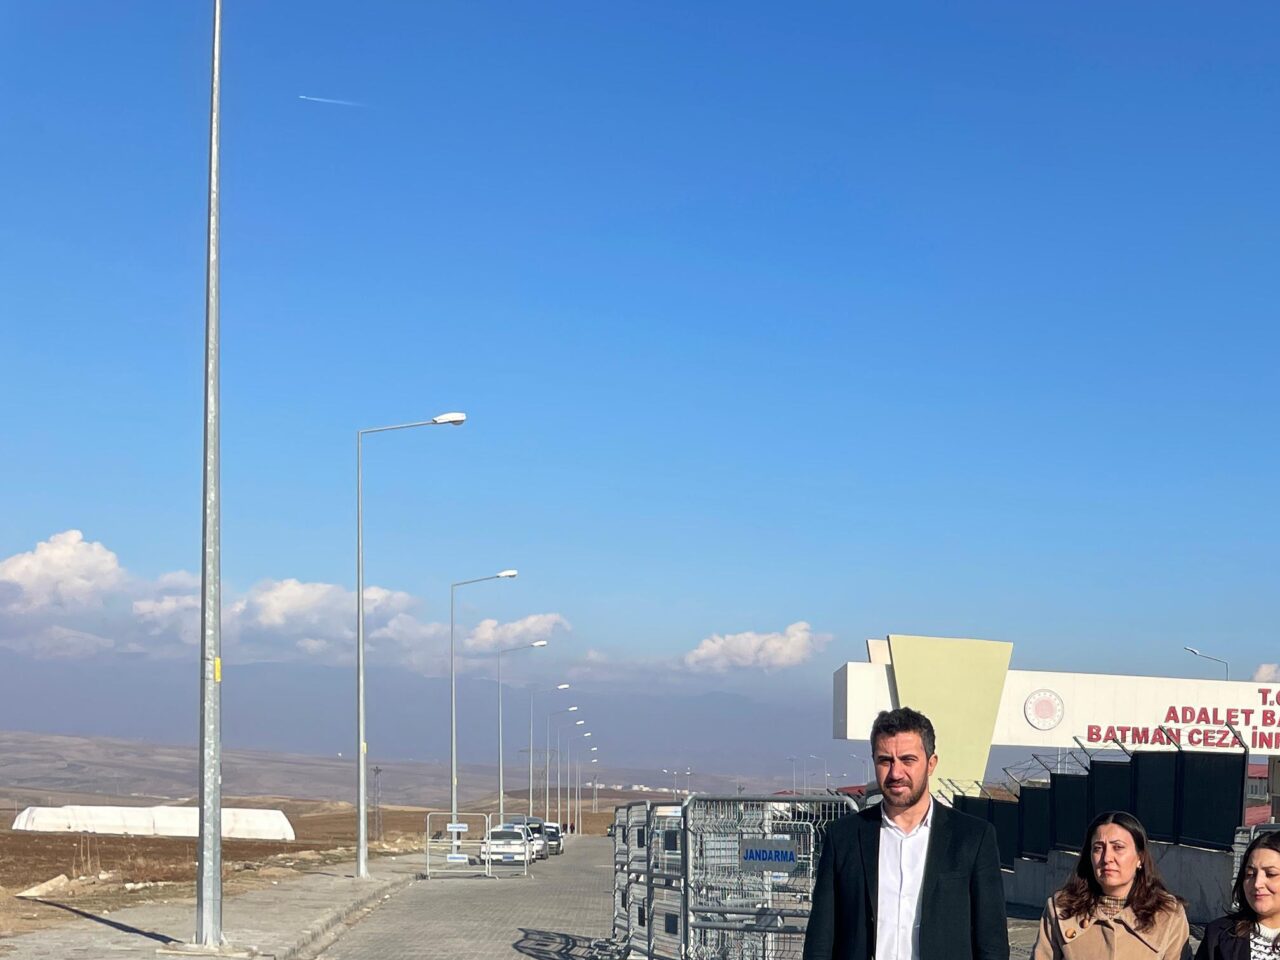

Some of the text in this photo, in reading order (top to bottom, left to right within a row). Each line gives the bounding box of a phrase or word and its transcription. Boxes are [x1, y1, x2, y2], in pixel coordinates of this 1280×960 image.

[1164, 706, 1254, 726] ADALET
[1087, 724, 1182, 746] BATMAN
[1187, 728, 1244, 748] CEZA
[743, 849, 795, 863] JANDARMA
